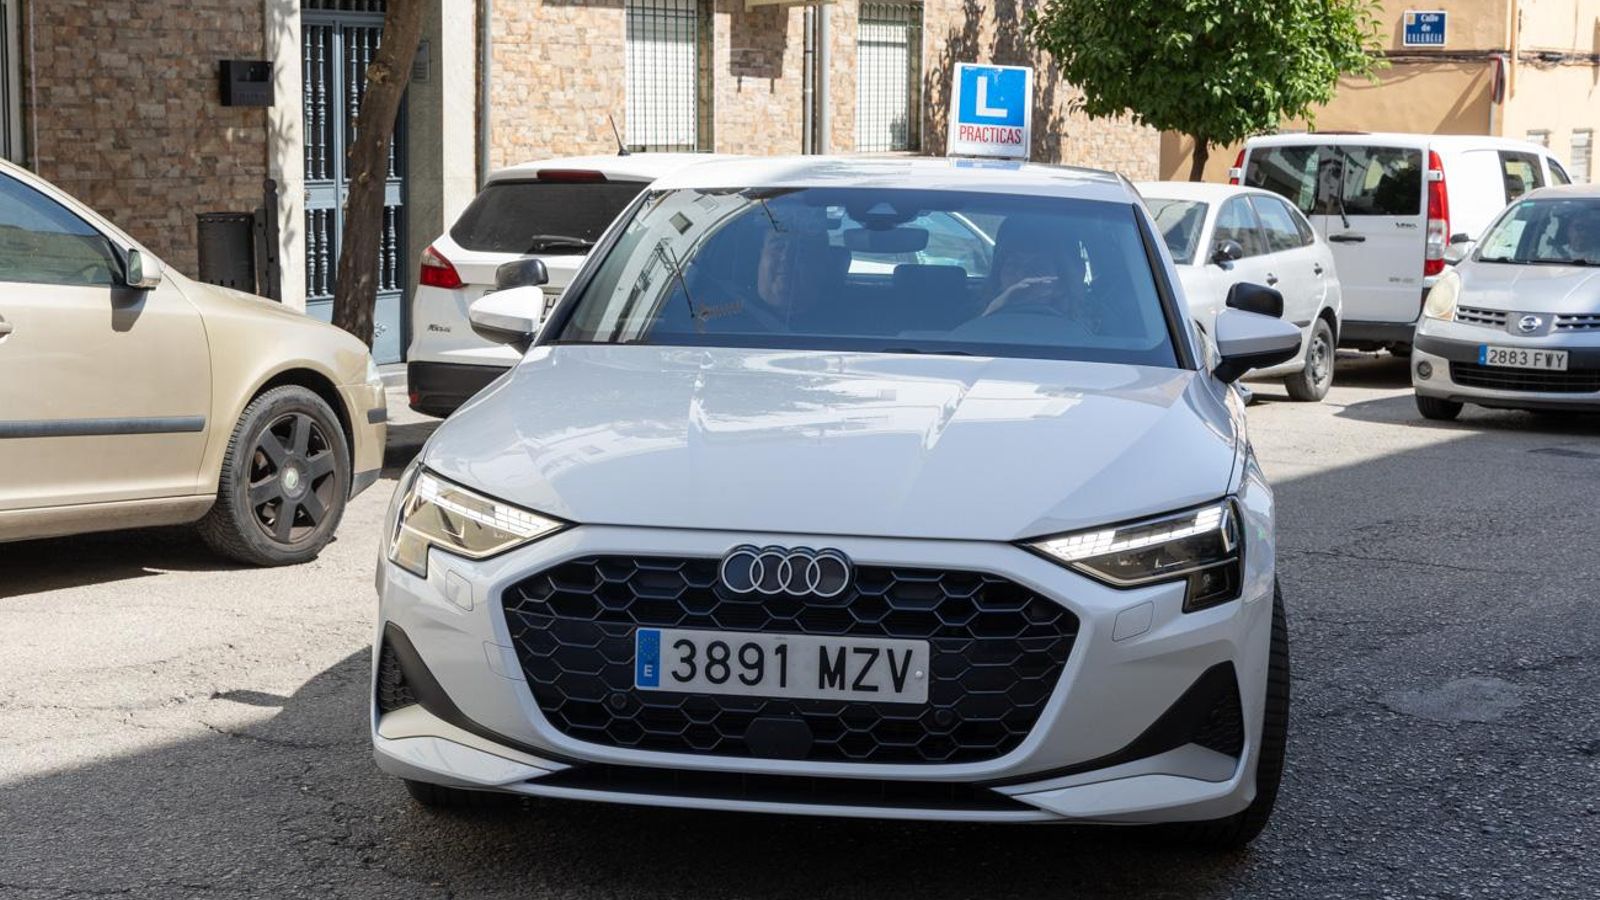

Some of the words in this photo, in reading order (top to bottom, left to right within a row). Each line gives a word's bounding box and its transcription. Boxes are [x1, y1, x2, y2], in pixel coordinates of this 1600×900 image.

[1421, 14, 1439, 22] Calle
[1421, 24, 1431, 32] de
[975, 76, 1008, 117] L
[959, 126, 1021, 144] PRACTICAS
[1489, 350, 1528, 366] 2883
[643, 663, 653, 678] E
[671, 639, 788, 688] 3891
[818, 645, 913, 693] MZV
